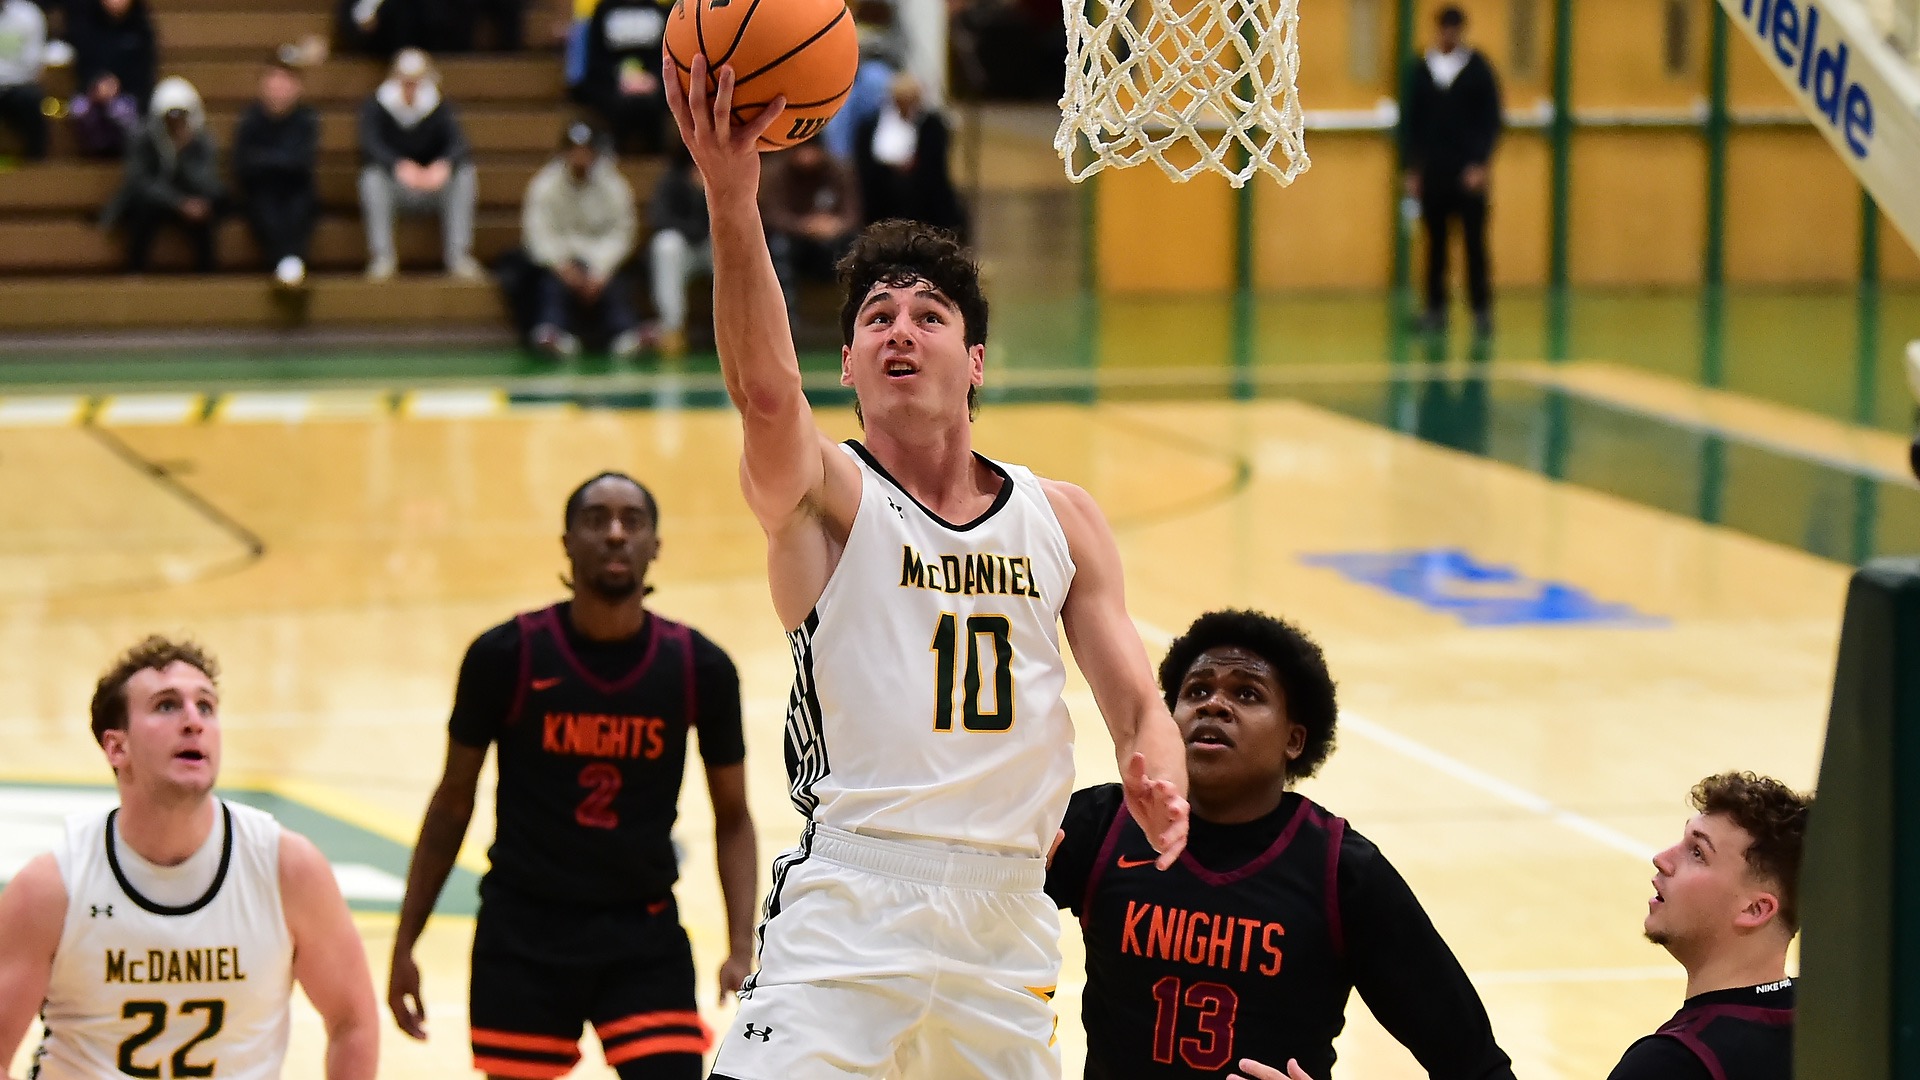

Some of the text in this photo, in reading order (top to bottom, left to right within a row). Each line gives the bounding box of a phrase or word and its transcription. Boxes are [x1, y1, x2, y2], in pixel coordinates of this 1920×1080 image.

[899, 544, 1041, 600] McDANIEL
[929, 611, 1016, 733] 10
[542, 712, 666, 760] KNIGHTS
[575, 763, 622, 830] 2
[105, 947, 247, 984] McDANIEL
[1121, 900, 1285, 976] KNIGHTS
[1756, 983, 1778, 994] NIKE
[117, 998, 226, 1079] 22
[1152, 976, 1239, 1071] 13
